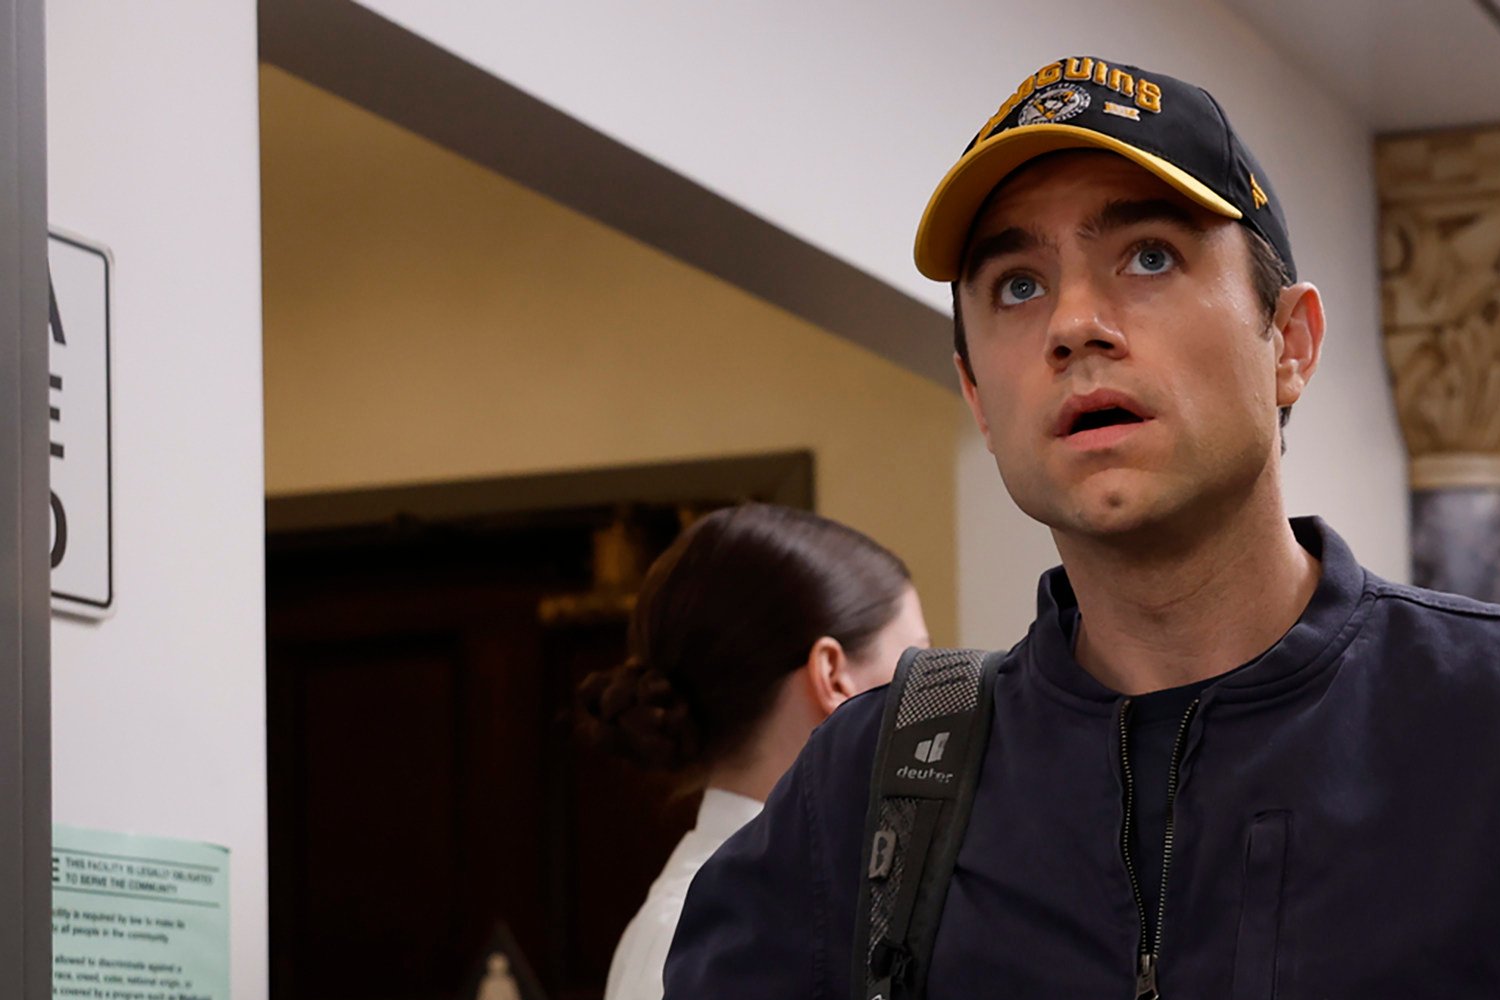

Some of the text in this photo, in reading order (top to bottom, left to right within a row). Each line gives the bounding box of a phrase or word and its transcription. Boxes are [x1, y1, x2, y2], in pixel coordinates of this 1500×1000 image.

[896, 765, 954, 784] deuter
[66, 857, 85, 869] THIS
[66, 872, 178, 894] TO SERVE THE COMMUNITY
[82, 911, 115, 924] required
[72, 926, 99, 938] people
[112, 928, 125, 938] the
[55, 955, 86, 965] allowed
